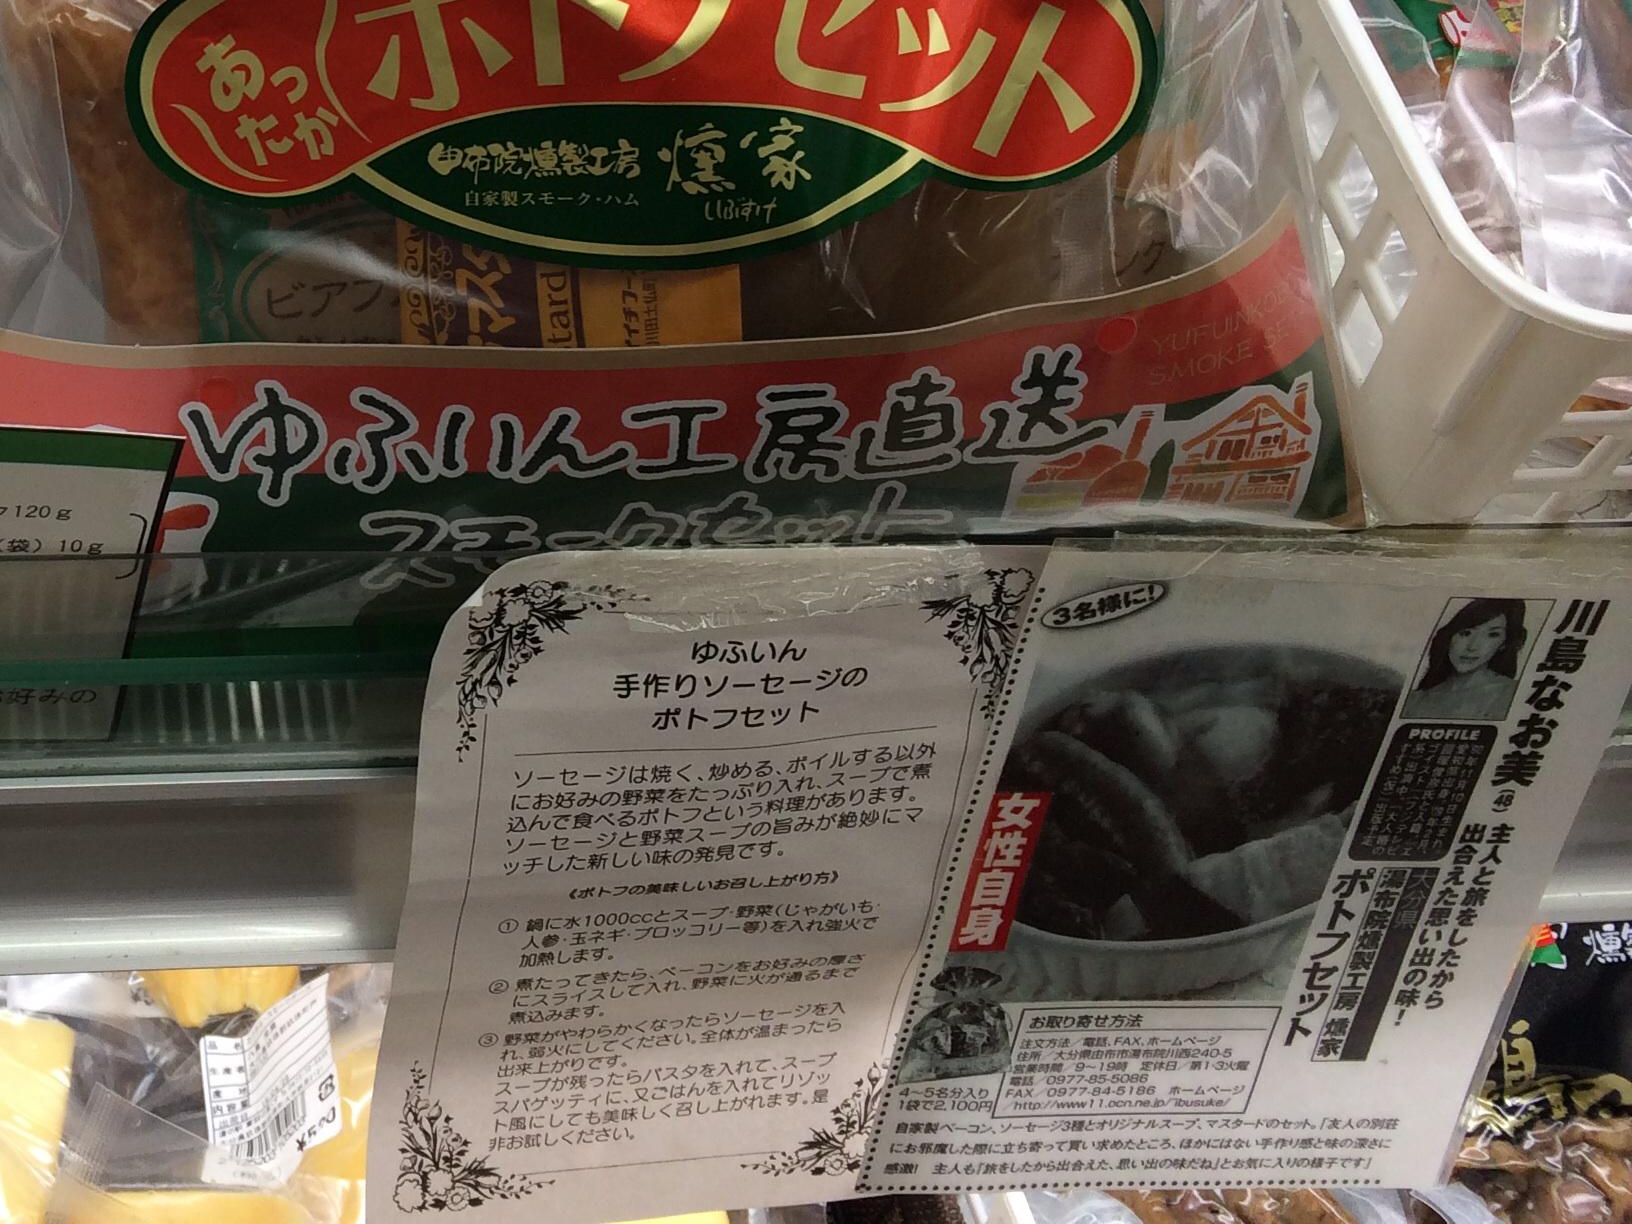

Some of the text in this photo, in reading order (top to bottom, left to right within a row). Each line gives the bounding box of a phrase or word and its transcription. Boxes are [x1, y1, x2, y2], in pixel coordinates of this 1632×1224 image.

[465, 190, 640, 207] 自家製スモーク・ハム
[540, 271, 574, 347] tard
[181, 344, 1110, 512] ゆふいん工房直送
[691, 639, 807, 664] ゆふいん
[613, 667, 868, 698] 手作りソーセージの
[1491, 599, 1611, 788] 川島なお美
[652, 701, 819, 730] ポトフセット
[1408, 729, 1481, 741] PROFILE
[510, 763, 933, 811] にお好みの野菜をたっぷり入れ、スープで煮
[506, 785, 918, 833] 込んで食べるポトフという料理があります。
[505, 807, 924, 852] ソーセージと野菜スープの旨みが絶妙にマ
[503, 840, 785, 875] ッチした新しい味の発見です。
[958, 793, 1041, 946] 女性自身
[1423, 824, 1515, 1010] 主人と旅をしたから
[518, 946, 616, 968] 加熱します。
[1284, 867, 1377, 1047] ポトフセット
[508, 1003, 606, 1024] 煮込みます。
[1028, 1014, 1144, 1029] お取り寄せ方法
[496, 1055, 628, 1078] 出来上がりです。
[1168, 1084, 1246, 1096] ホームページ
[489, 1129, 636, 1153] 非お試しください。
